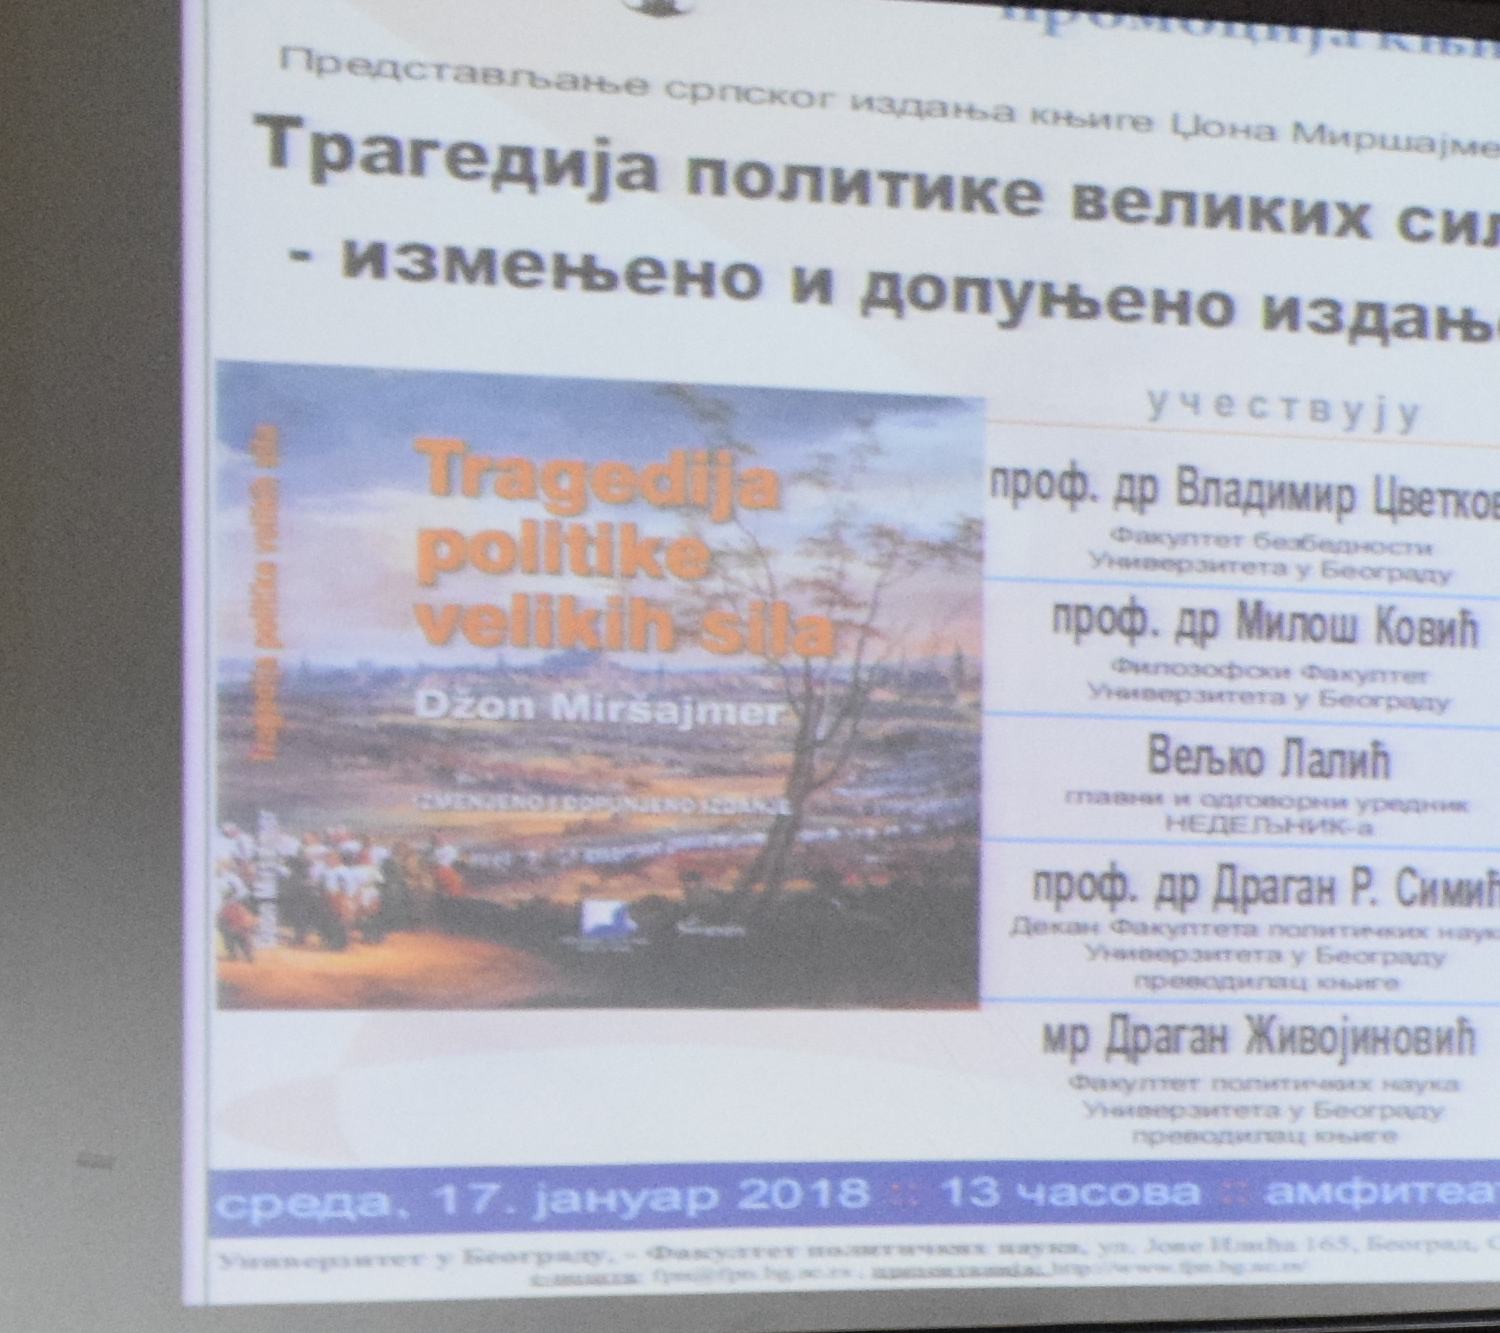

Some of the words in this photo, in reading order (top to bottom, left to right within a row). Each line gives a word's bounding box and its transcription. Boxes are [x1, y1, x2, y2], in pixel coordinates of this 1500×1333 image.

[279, 45, 648, 98] Представљање
[666, 76, 834, 110] српског
[852, 93, 1016, 123] издања
[1031, 107, 1154, 135] књиге
[1172, 112, 1277, 142] Џона
[252, 112, 659, 202] Трагедија
[687, 156, 1044, 218] политике
[1071, 181, 1372, 241] великих
[342, 239, 763, 302] измењено
[792, 264, 833, 306] и
[860, 270, 1236, 330] допуњено
[413, 435, 783, 523] Tragedija
[990, 459, 1099, 511] проф.
[1114, 469, 1160, 514] др
[1176, 465, 1357, 522] Владимир
[417, 518, 713, 587] politike
[1110, 525, 1245, 552] Факултет
[1320, 560, 1455, 587] Београду
[414, 592, 676, 652] velikih
[699, 600, 837, 658] sila
[1053, 596, 1160, 646] проф.
[1175, 603, 1219, 649] др
[1236, 600, 1358, 645] Милош
[1375, 606, 1480, 649] Ковић
[415, 688, 535, 722] Džon
[551, 691, 787, 731] Miršajmer
[1147, 733, 1265, 777] Вељко
[1280, 736, 1391, 780] Лалић
[1034, 862, 1138, 908] проф.
[1155, 870, 1200, 911] др
[1213, 862, 1336, 912] Драган
[1352, 866, 1378, 906] Р.
[1043, 1021, 1090, 1060] мр
[1106, 1013, 1229, 1064] Драган
[1245, 1013, 1477, 1067] Живојиновић
[213, 1188, 409, 1227] среда,
[431, 1182, 517, 1216] 17.
[530, 1180, 720, 1220] јануар
[736, 1176, 872, 1210] 2018
[943, 1176, 1001, 1207] 13
[1016, 1178, 1200, 1207] часова
